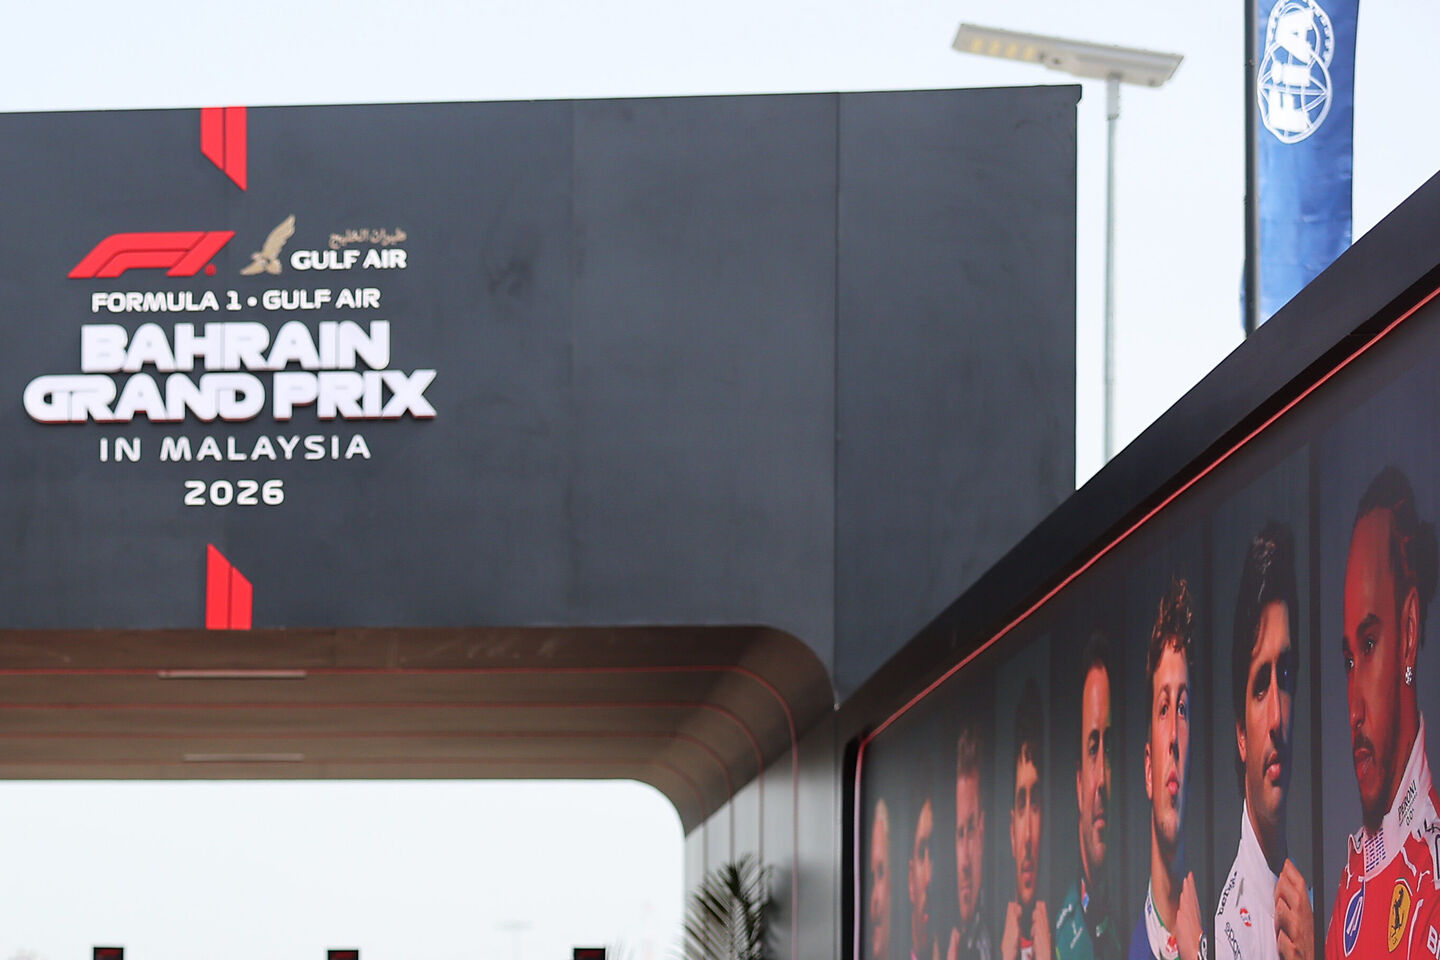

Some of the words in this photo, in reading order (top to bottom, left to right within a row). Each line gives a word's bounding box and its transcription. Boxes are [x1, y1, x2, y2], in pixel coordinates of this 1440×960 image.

[290, 249, 361, 271] GULF
[362, 248, 408, 270] AIR
[91, 290, 220, 313] FORMULA
[226, 290, 242, 312] 1
[262, 289, 331, 311] GULF
[335, 287, 381, 310] AIR
[80, 319, 391, 373] BAHRAIN
[23, 371, 266, 424] GRAND
[272, 368, 438, 421] PRIX
[100, 437, 141, 463] IN
[160, 434, 372, 462] MALAYSIA
[184, 480, 286, 506] 2026
